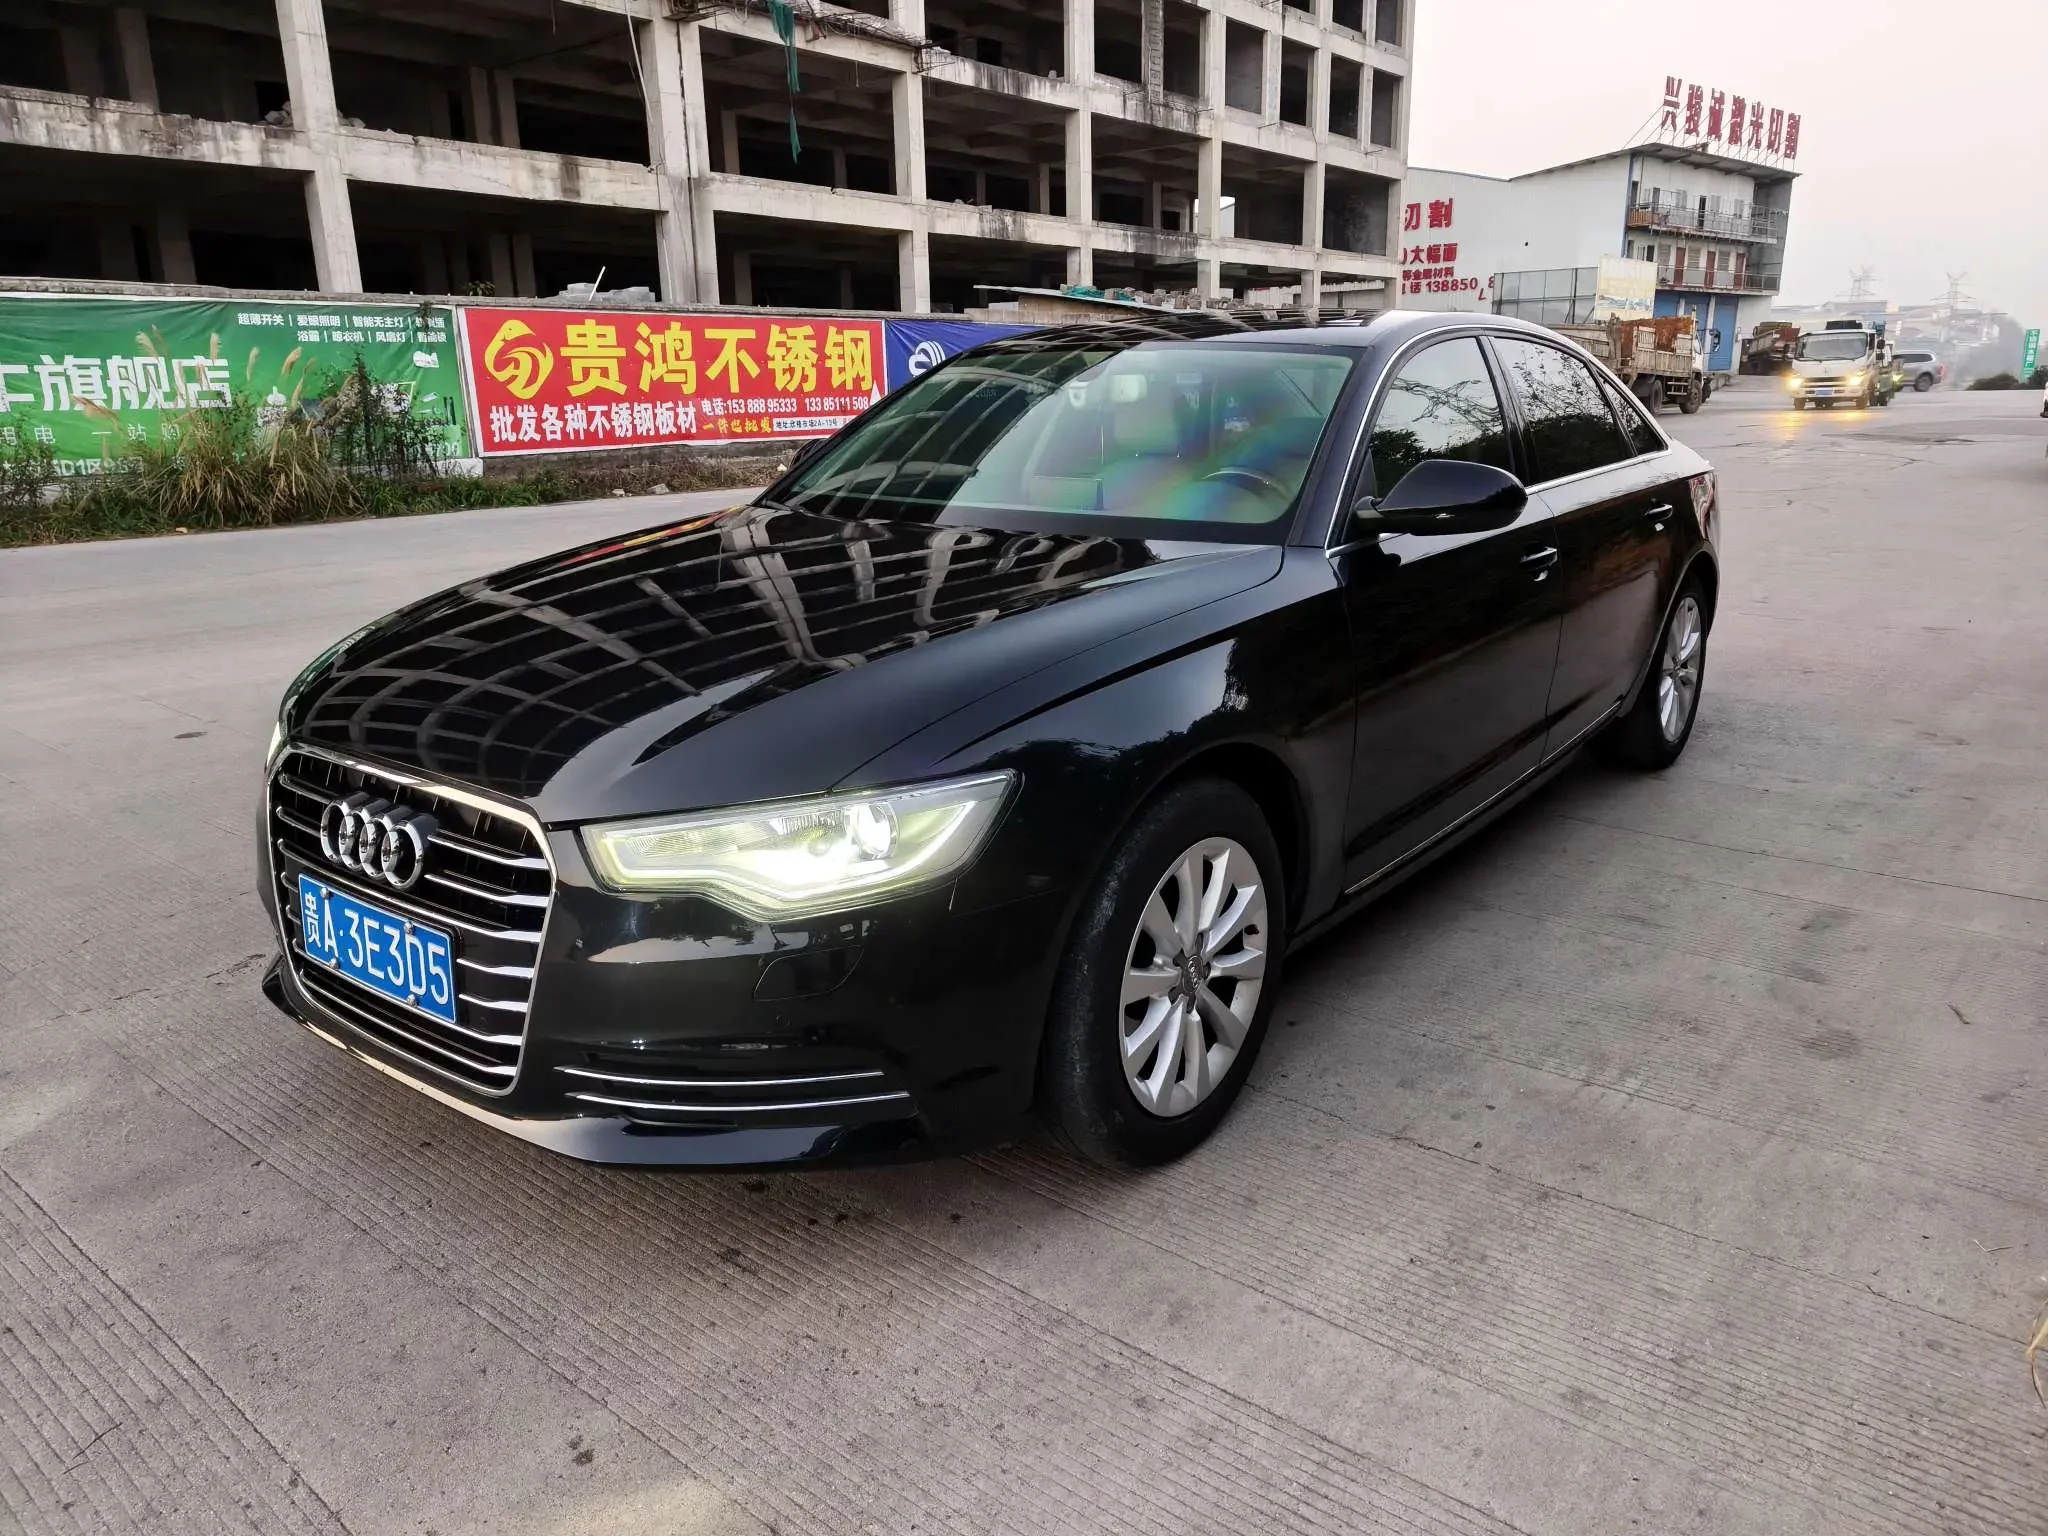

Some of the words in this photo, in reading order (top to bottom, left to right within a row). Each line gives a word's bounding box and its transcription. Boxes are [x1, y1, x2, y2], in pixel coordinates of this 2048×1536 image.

[560, 319, 873, 397] 贵鸿不锈钢
[747, 399, 765, 413] 888
[767, 398, 797, 413] 95333
[804, 398, 823, 412] 133
[852, 396, 869, 410] 508
[92, 423, 216, 442] 一站购
[490, 401, 697, 443] 批发各种不锈钢板材
